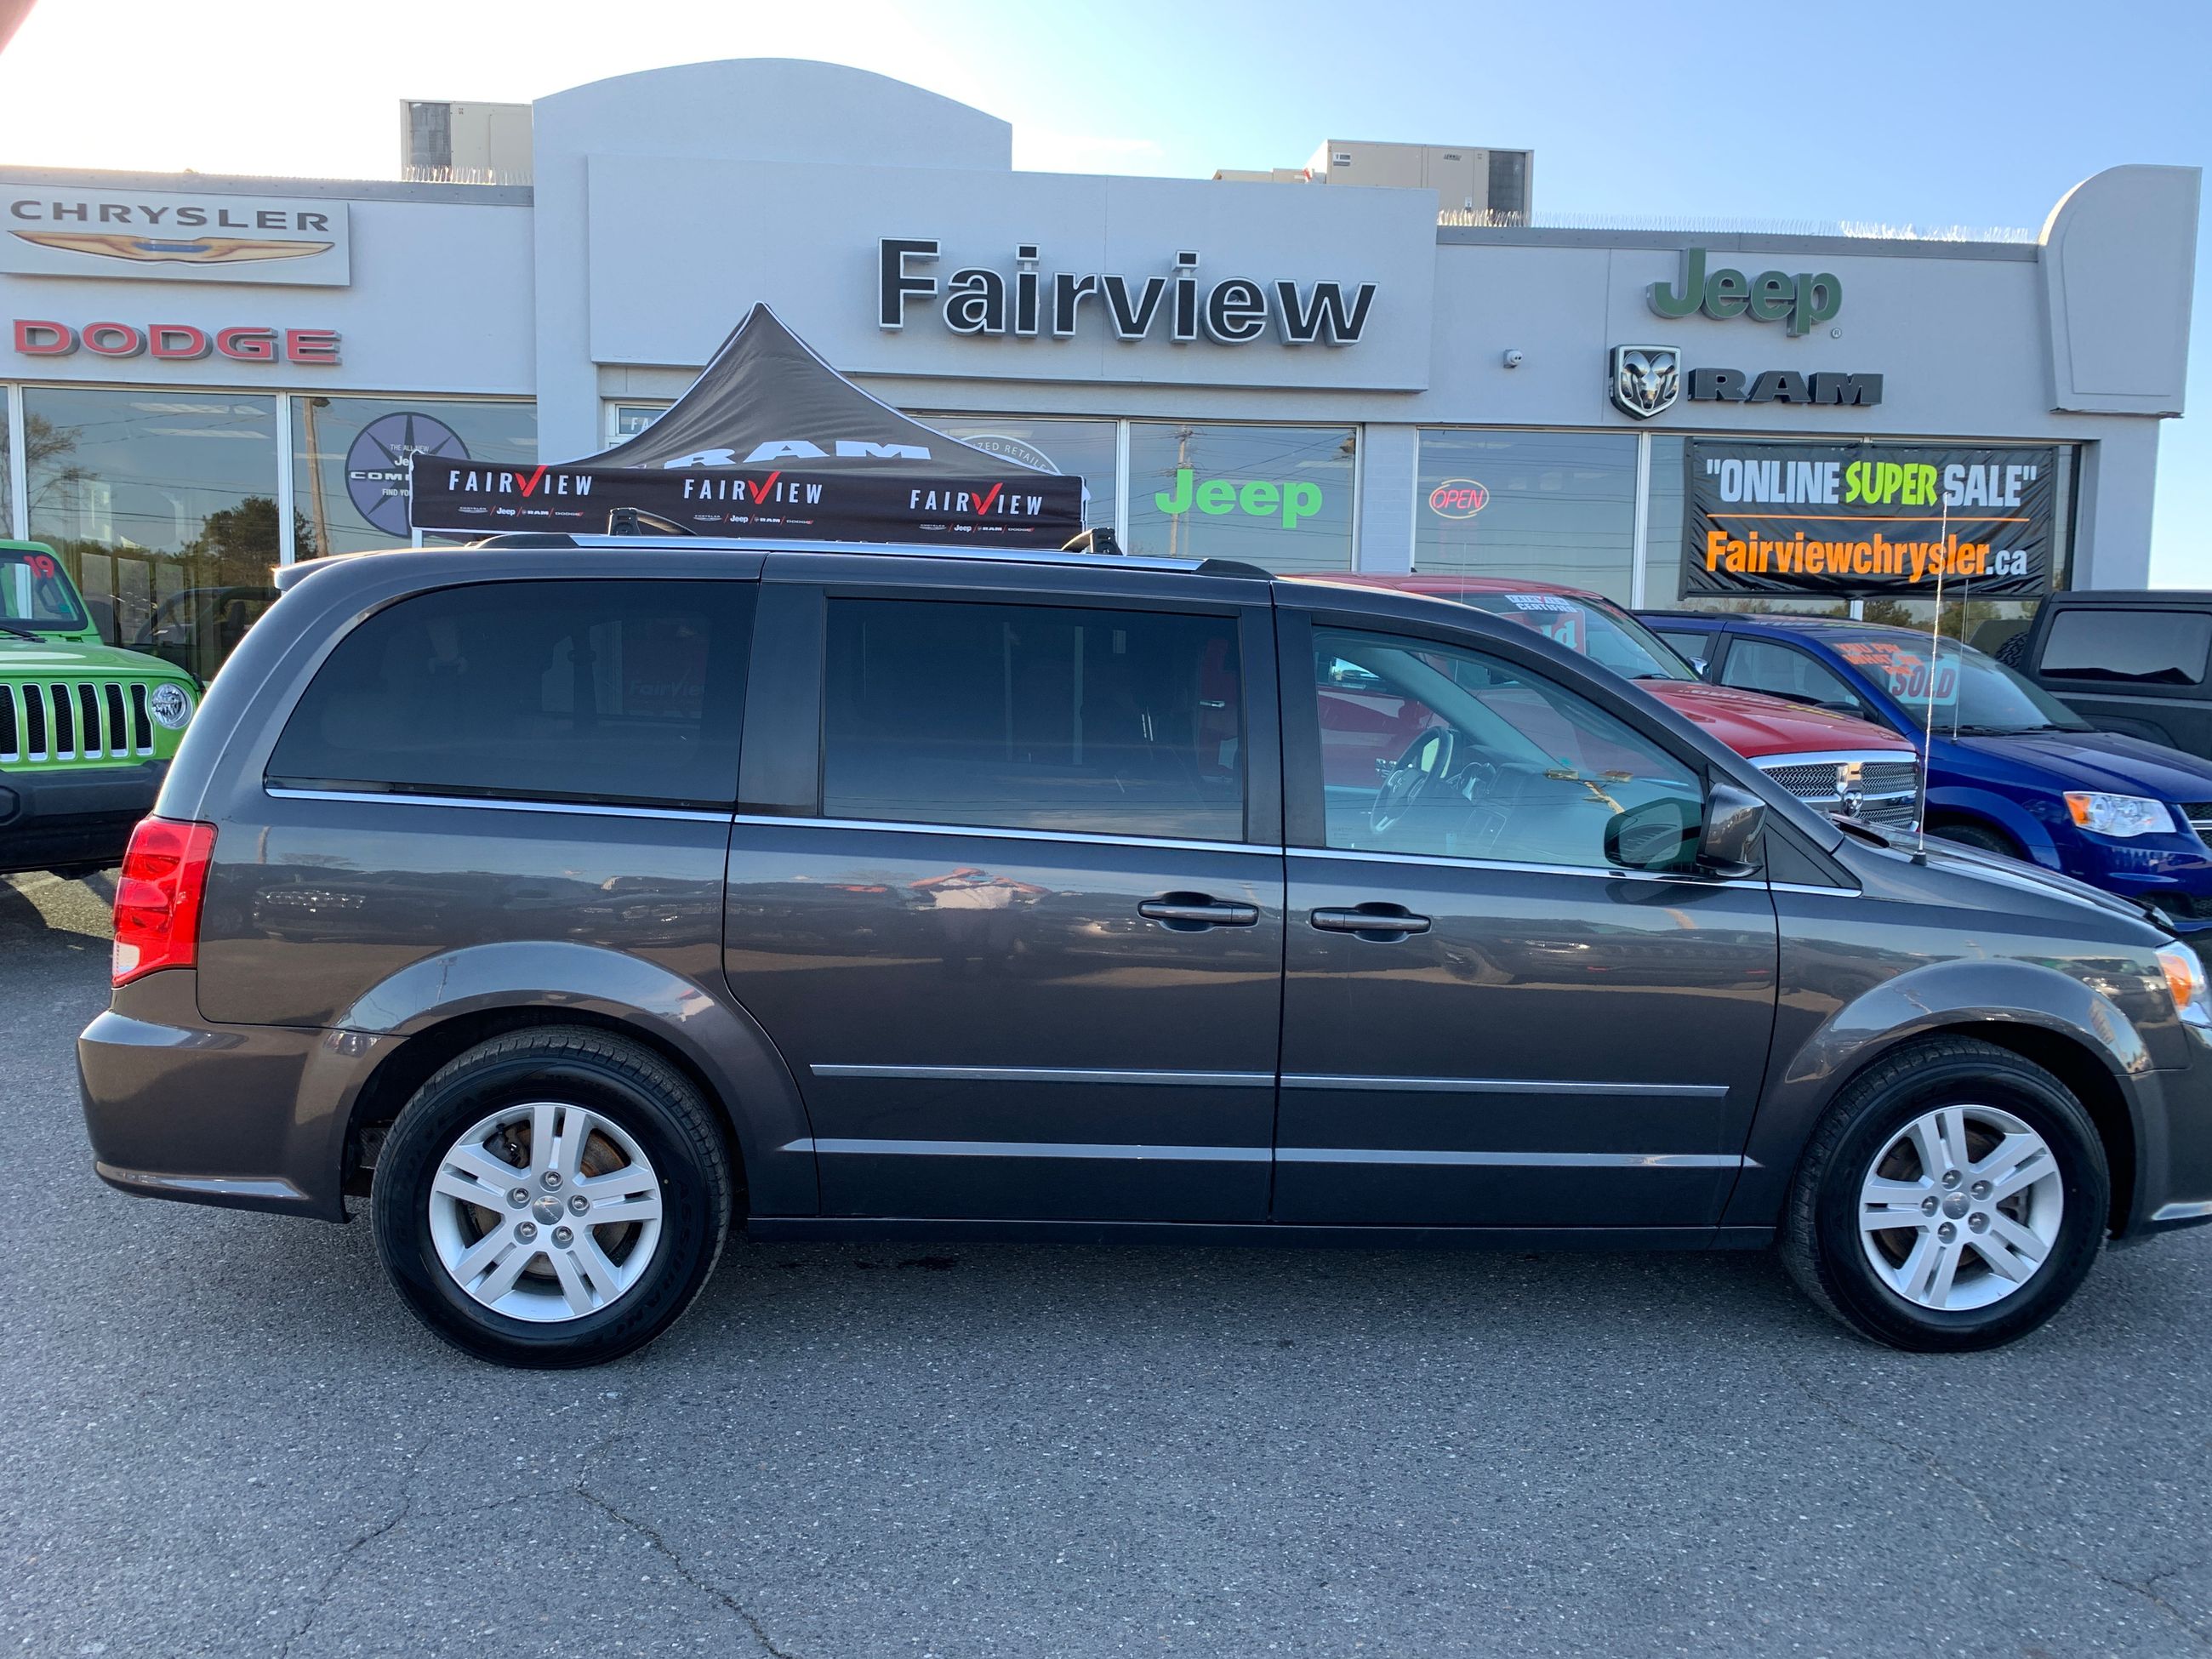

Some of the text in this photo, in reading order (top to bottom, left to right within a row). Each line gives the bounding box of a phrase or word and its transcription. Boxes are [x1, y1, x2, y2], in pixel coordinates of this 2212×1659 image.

[10, 199, 329, 232] CHRYSLER
[877, 236, 1379, 346] Fairview
[1646, 248, 1843, 337] Jeep
[13, 318, 342, 366] DODGE
[1687, 368, 1884, 406] RAM
[664, 440, 931, 469] RAM
[1004, 444, 1048, 471] RETAILE
[382, 488, 398, 497] FIND
[448, 464, 592, 498] FAIRVIEW
[683, 470, 823, 505] FAIRVIEW
[1154, 468, 1323, 528] Jeep
[1707, 458, 2037, 507] "ONLINE SUPER SALE"
[496, 507, 516, 516] Jeep
[909, 482, 1043, 516] FAIRVIEW
[1433, 488, 1485, 509] OPEN
[730, 515, 749, 523] Jeep
[954, 524, 972, 533] Jeep
[23, 555, 55, 579] 19
[1706, 530, 2027, 583] Fairviewchrysler.ca
[1516, 602, 1578, 613] CERTIFIED
[1891, 664, 1958, 699] SOLD
